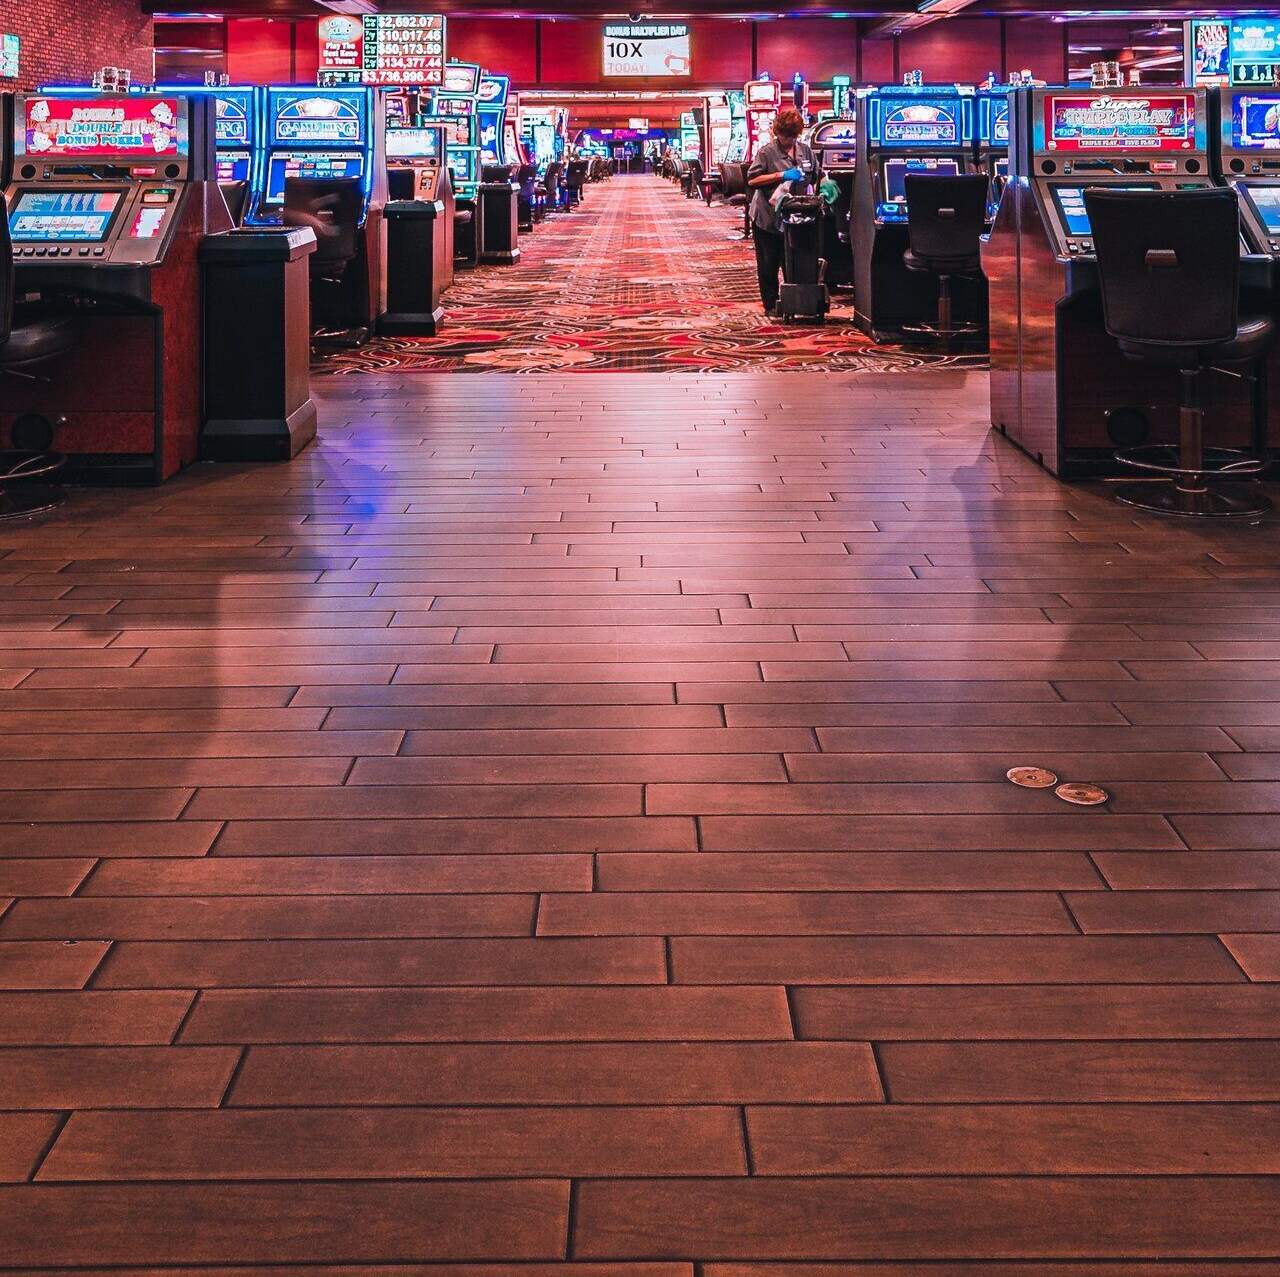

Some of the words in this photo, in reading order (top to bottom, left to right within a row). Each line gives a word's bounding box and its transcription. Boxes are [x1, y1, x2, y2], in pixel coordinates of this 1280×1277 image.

[607, 42, 643, 58] 10X
[1090, 95, 1150, 112] Super
[1065, 108, 1126, 125] TRIPLE
[1129, 108, 1173, 125] PLAY
[71, 122, 123, 133] DOUBLE
[1081, 126, 1116, 136] DRAW
[1119, 126, 1158, 136] POKER
[57, 134, 98, 146] BONUS
[100, 134, 143, 146] POKER
